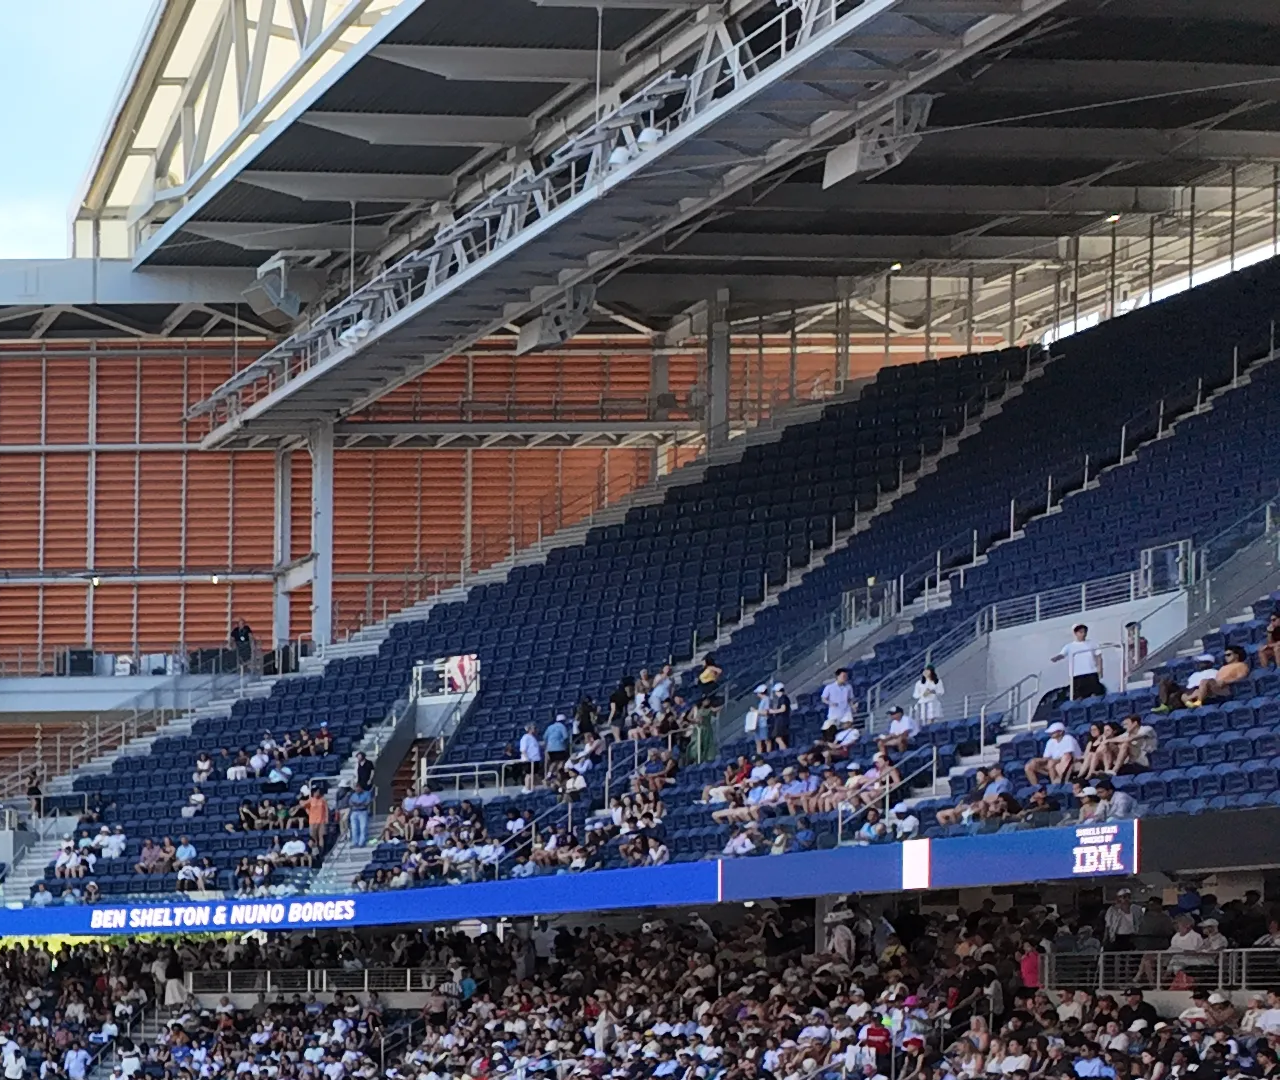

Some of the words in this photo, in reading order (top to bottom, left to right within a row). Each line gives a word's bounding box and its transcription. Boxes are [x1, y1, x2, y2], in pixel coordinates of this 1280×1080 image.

[1072, 843, 1124, 873] IBM
[91, 909, 126, 928] BEN
[129, 906, 210, 928] SHELTON
[213, 905, 227, 925] &
[230, 904, 286, 925] NUNO
[288, 900, 356, 922] BORGES
